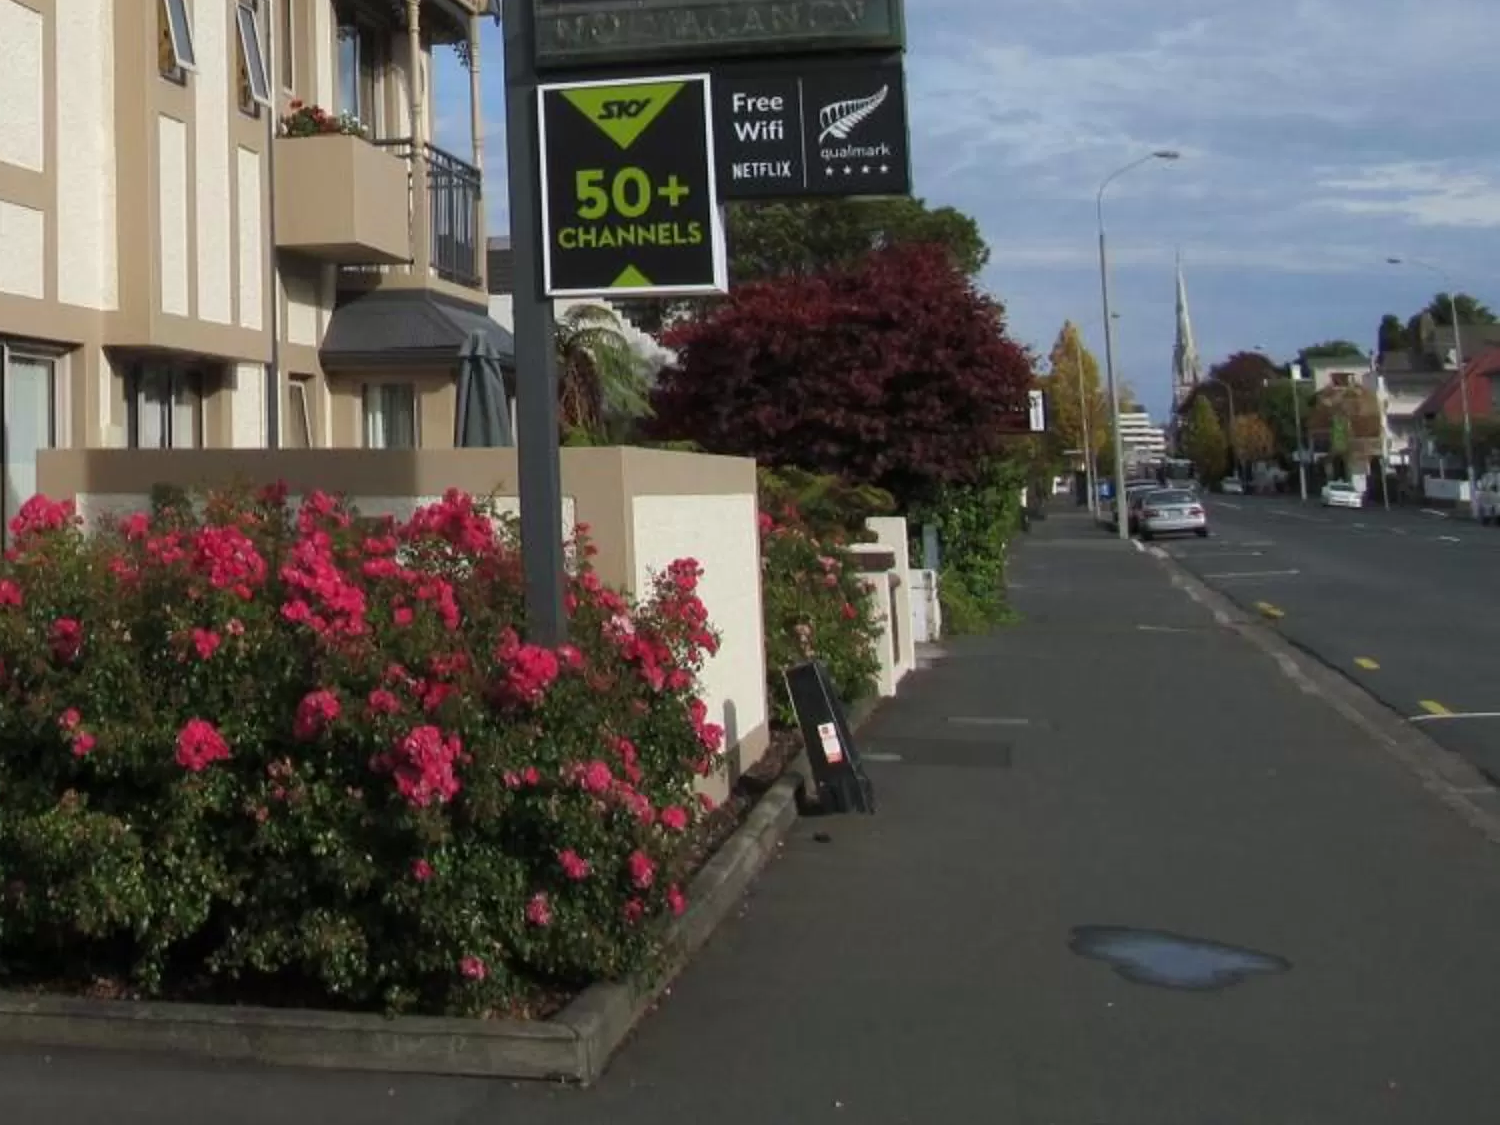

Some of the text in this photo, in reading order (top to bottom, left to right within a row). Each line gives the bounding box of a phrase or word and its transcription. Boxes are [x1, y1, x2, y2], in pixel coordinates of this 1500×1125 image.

[732, 92, 784, 113] Free
[734, 119, 784, 142] Wifi
[820, 143, 891, 161] qualmark
[732, 160, 792, 179] NETFLIX
[575, 166, 690, 220] 50+
[558, 222, 702, 249] CHANNELS
